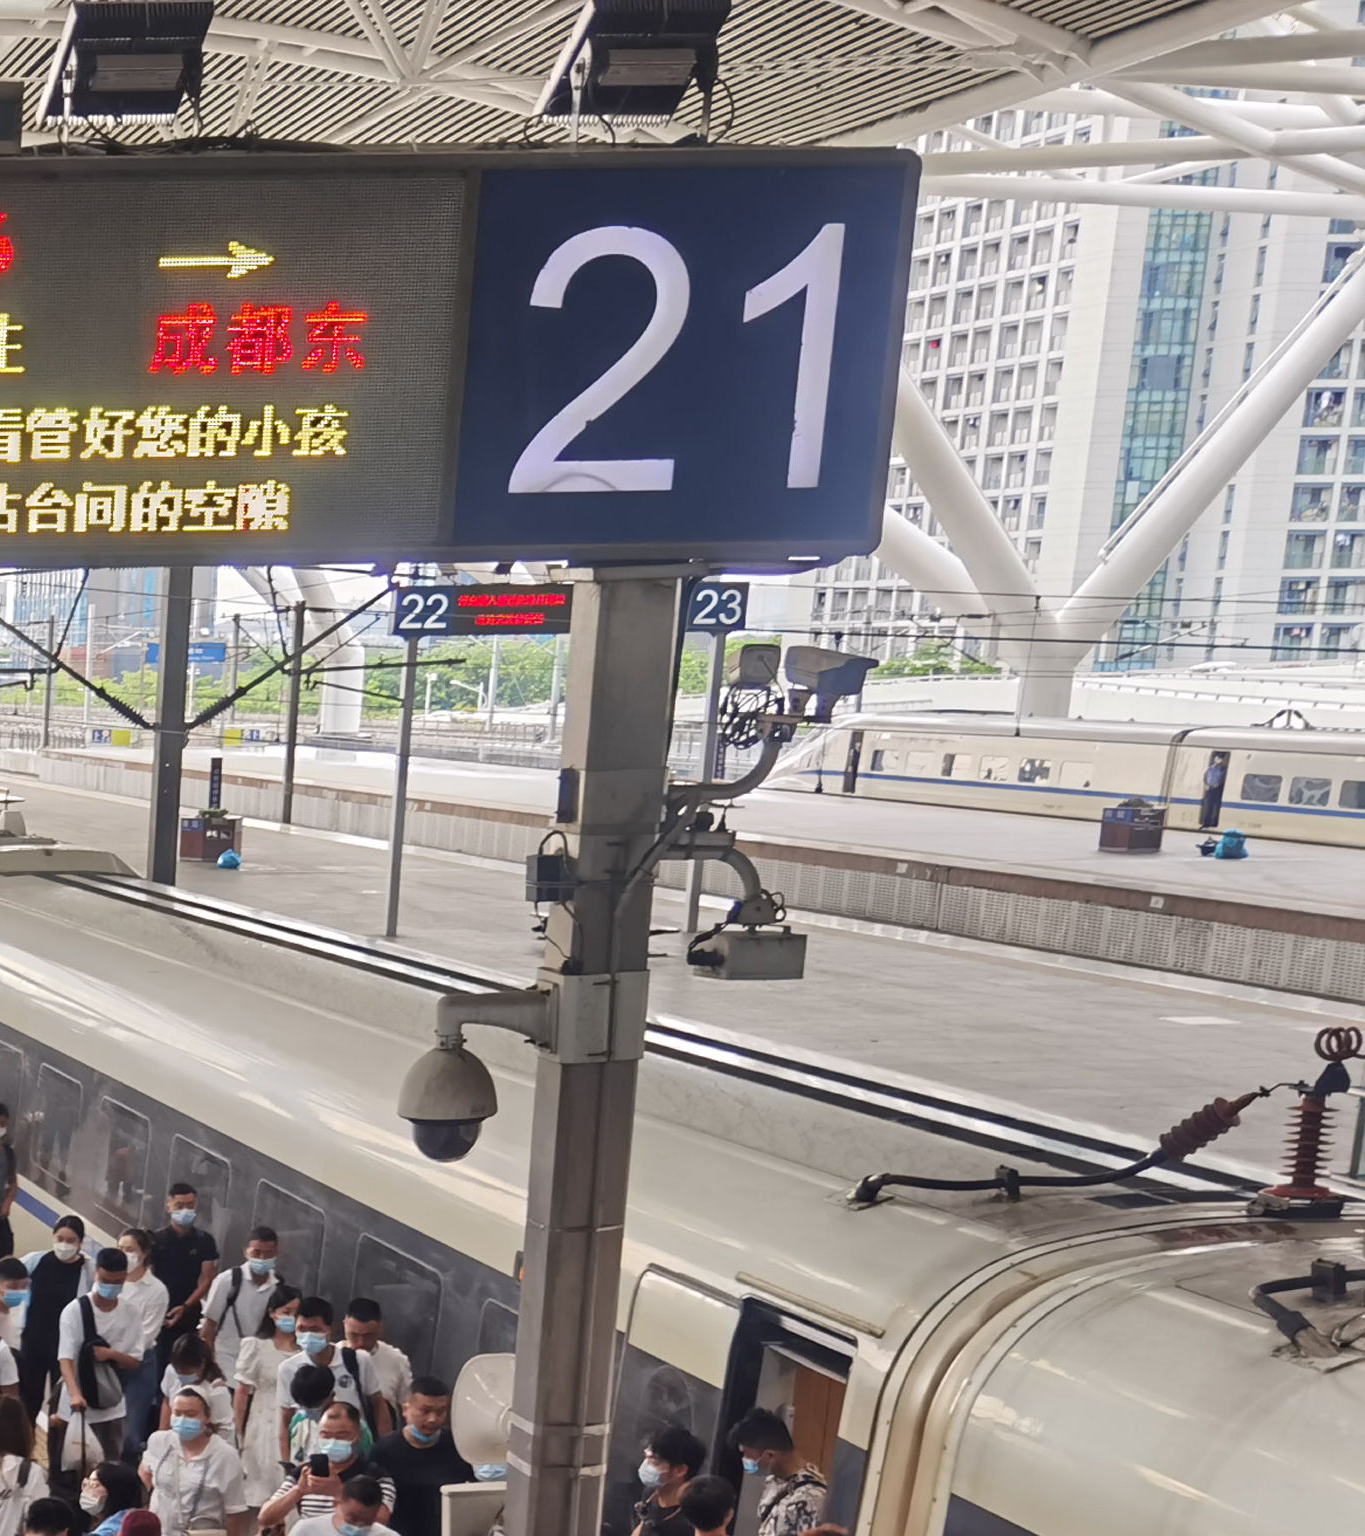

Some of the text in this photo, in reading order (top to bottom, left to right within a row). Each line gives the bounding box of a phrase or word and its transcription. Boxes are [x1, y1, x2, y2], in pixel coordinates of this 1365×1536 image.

[147, 301, 370, 374] 成都东
[507, 223, 846, 494] 21
[398, 594, 448, 630] 22
[692, 589, 743, 626] 23
